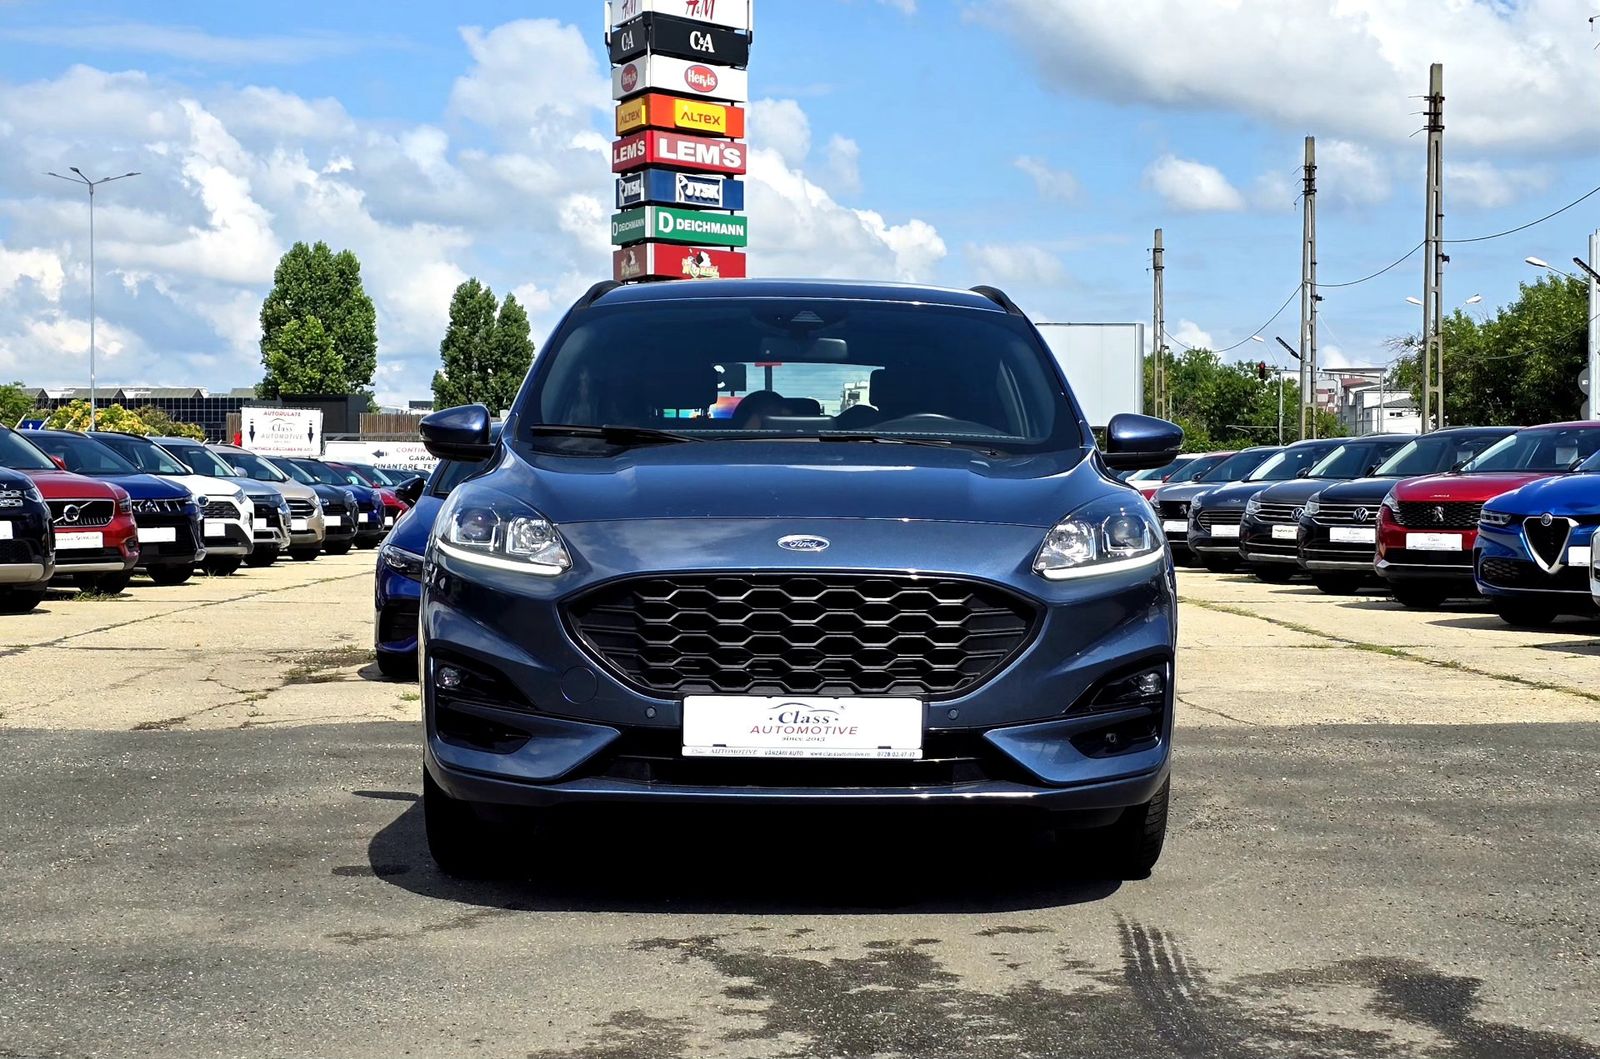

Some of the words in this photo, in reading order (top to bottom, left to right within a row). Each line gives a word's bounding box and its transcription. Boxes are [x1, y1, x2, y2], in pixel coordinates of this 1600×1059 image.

[613, 139, 646, 164] LEM'S
[659, 138, 742, 168] LEM'S
[685, 182, 720, 200] JYSK
[675, 218, 744, 237] DEICHMANN
[778, 710, 830, 725] Class
[750, 725, 859, 736] AUTOMOTIVE
